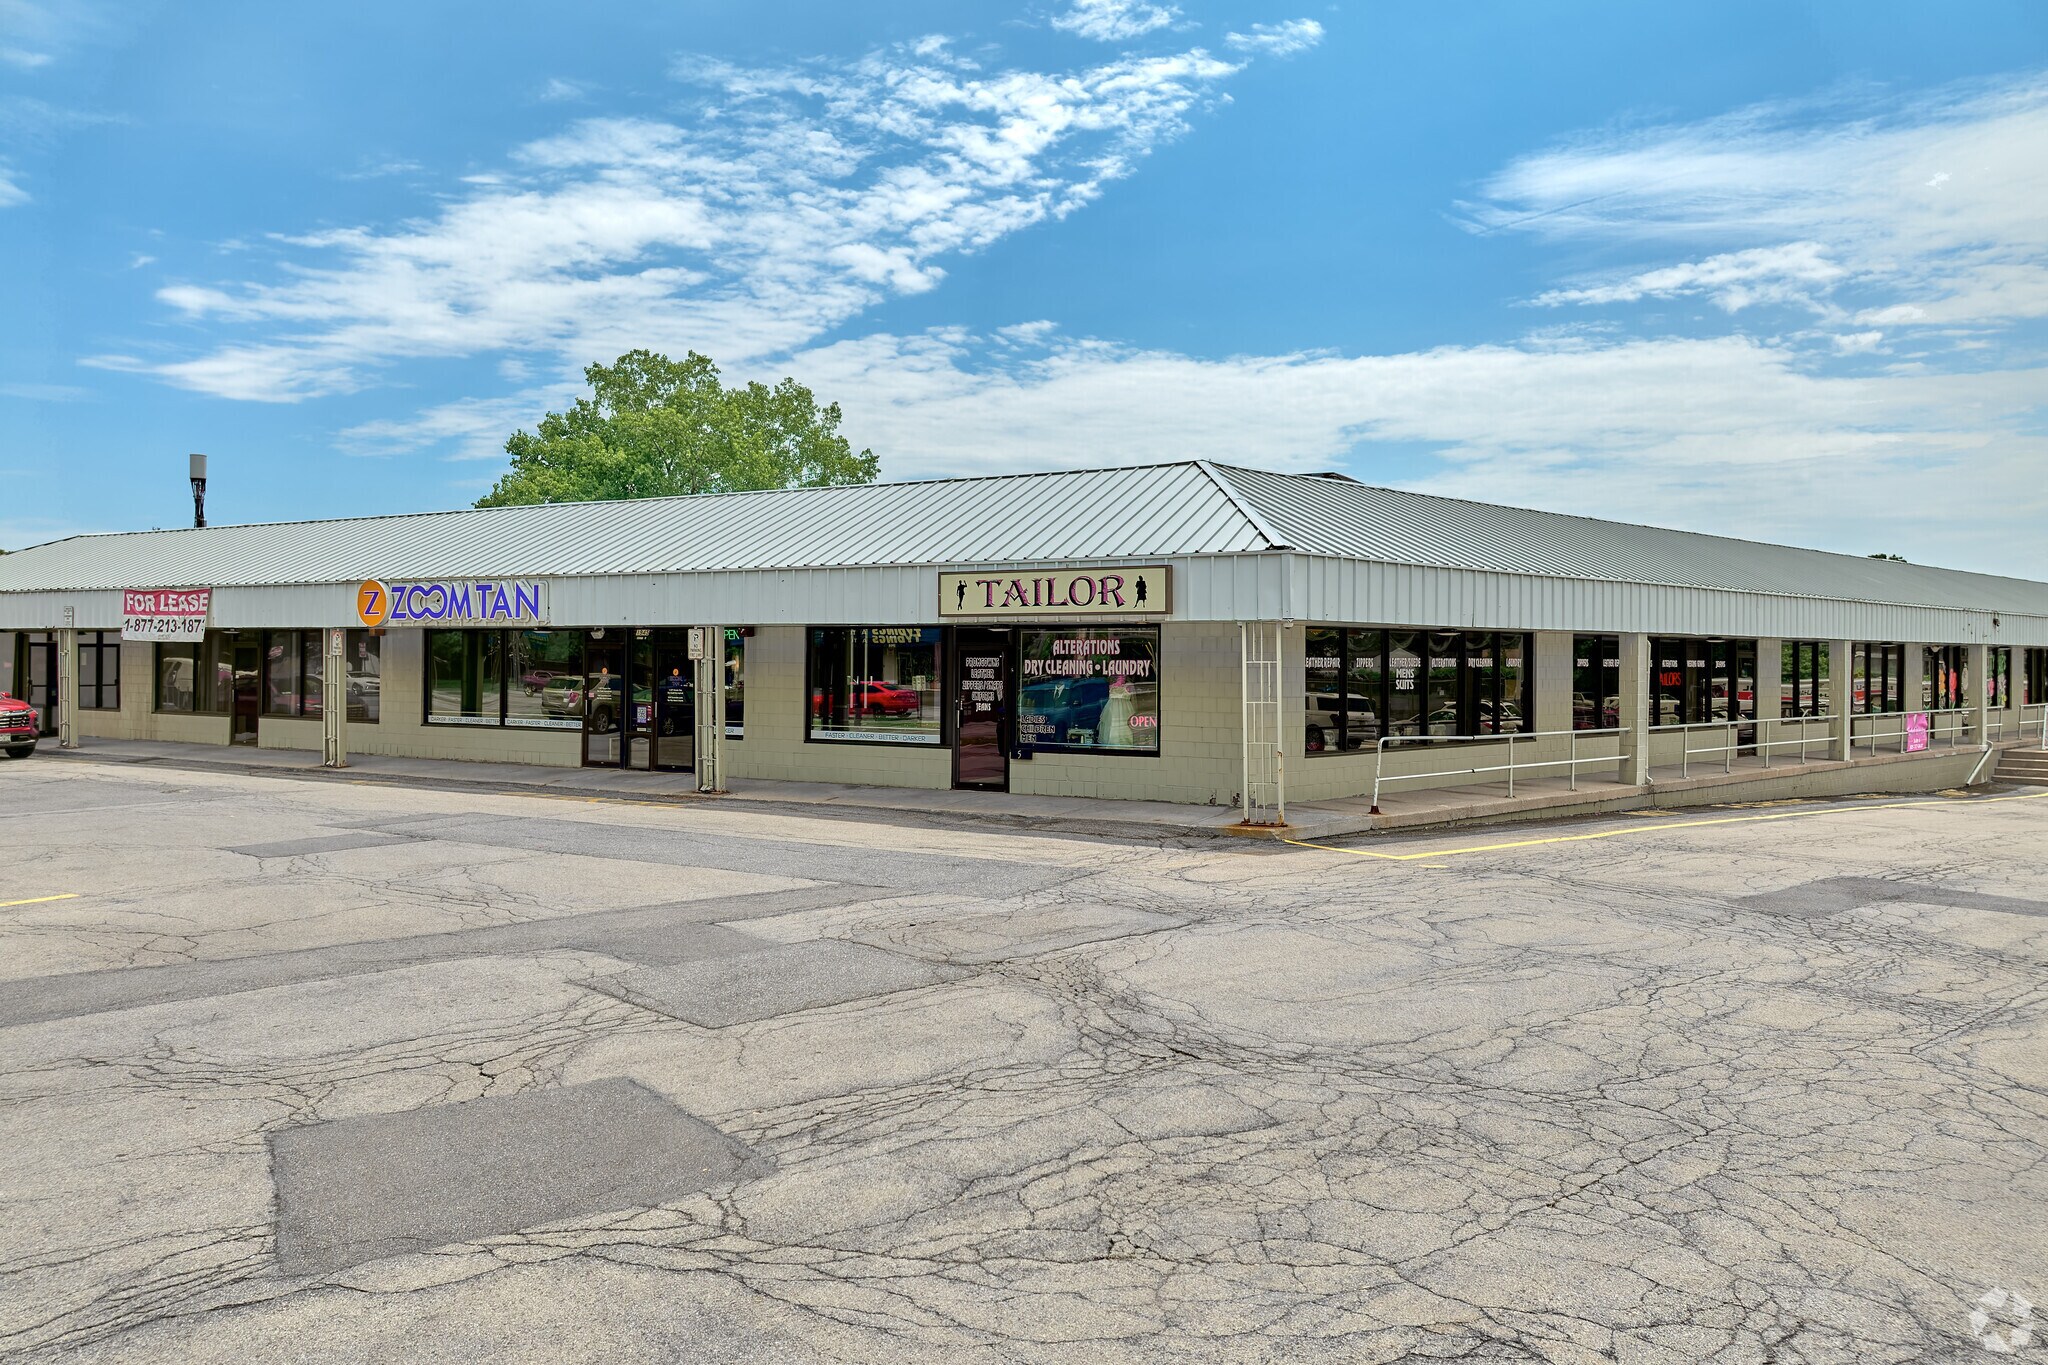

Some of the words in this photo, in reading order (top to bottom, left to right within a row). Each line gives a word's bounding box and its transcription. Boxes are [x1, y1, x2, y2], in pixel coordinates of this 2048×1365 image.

[975, 574, 1127, 609] TAILOR
[126, 593, 156, 612] FOR
[160, 592, 209, 612] LEASE
[724, 629, 740, 640] PEN
[1052, 639, 1121, 657] ALTERATIONS
[1024, 659, 1045, 676] DRY
[1045, 659, 1094, 676] CLEANING
[1101, 659, 1151, 677] LAUNDRY
[1356, 657, 1374, 669] ZIPPERS
[1396, 668, 1415, 679] MENS
[1660, 672, 1682, 687] AILORS
[1395, 679, 1415, 690] SUITS
[975, 702, 992, 713] JEANS
[1129, 714, 1157, 728] OPEN
[824, 731, 846, 739] FASTER
[848, 732, 876, 740] CLEANER
[878, 733, 900, 741] BETTER
